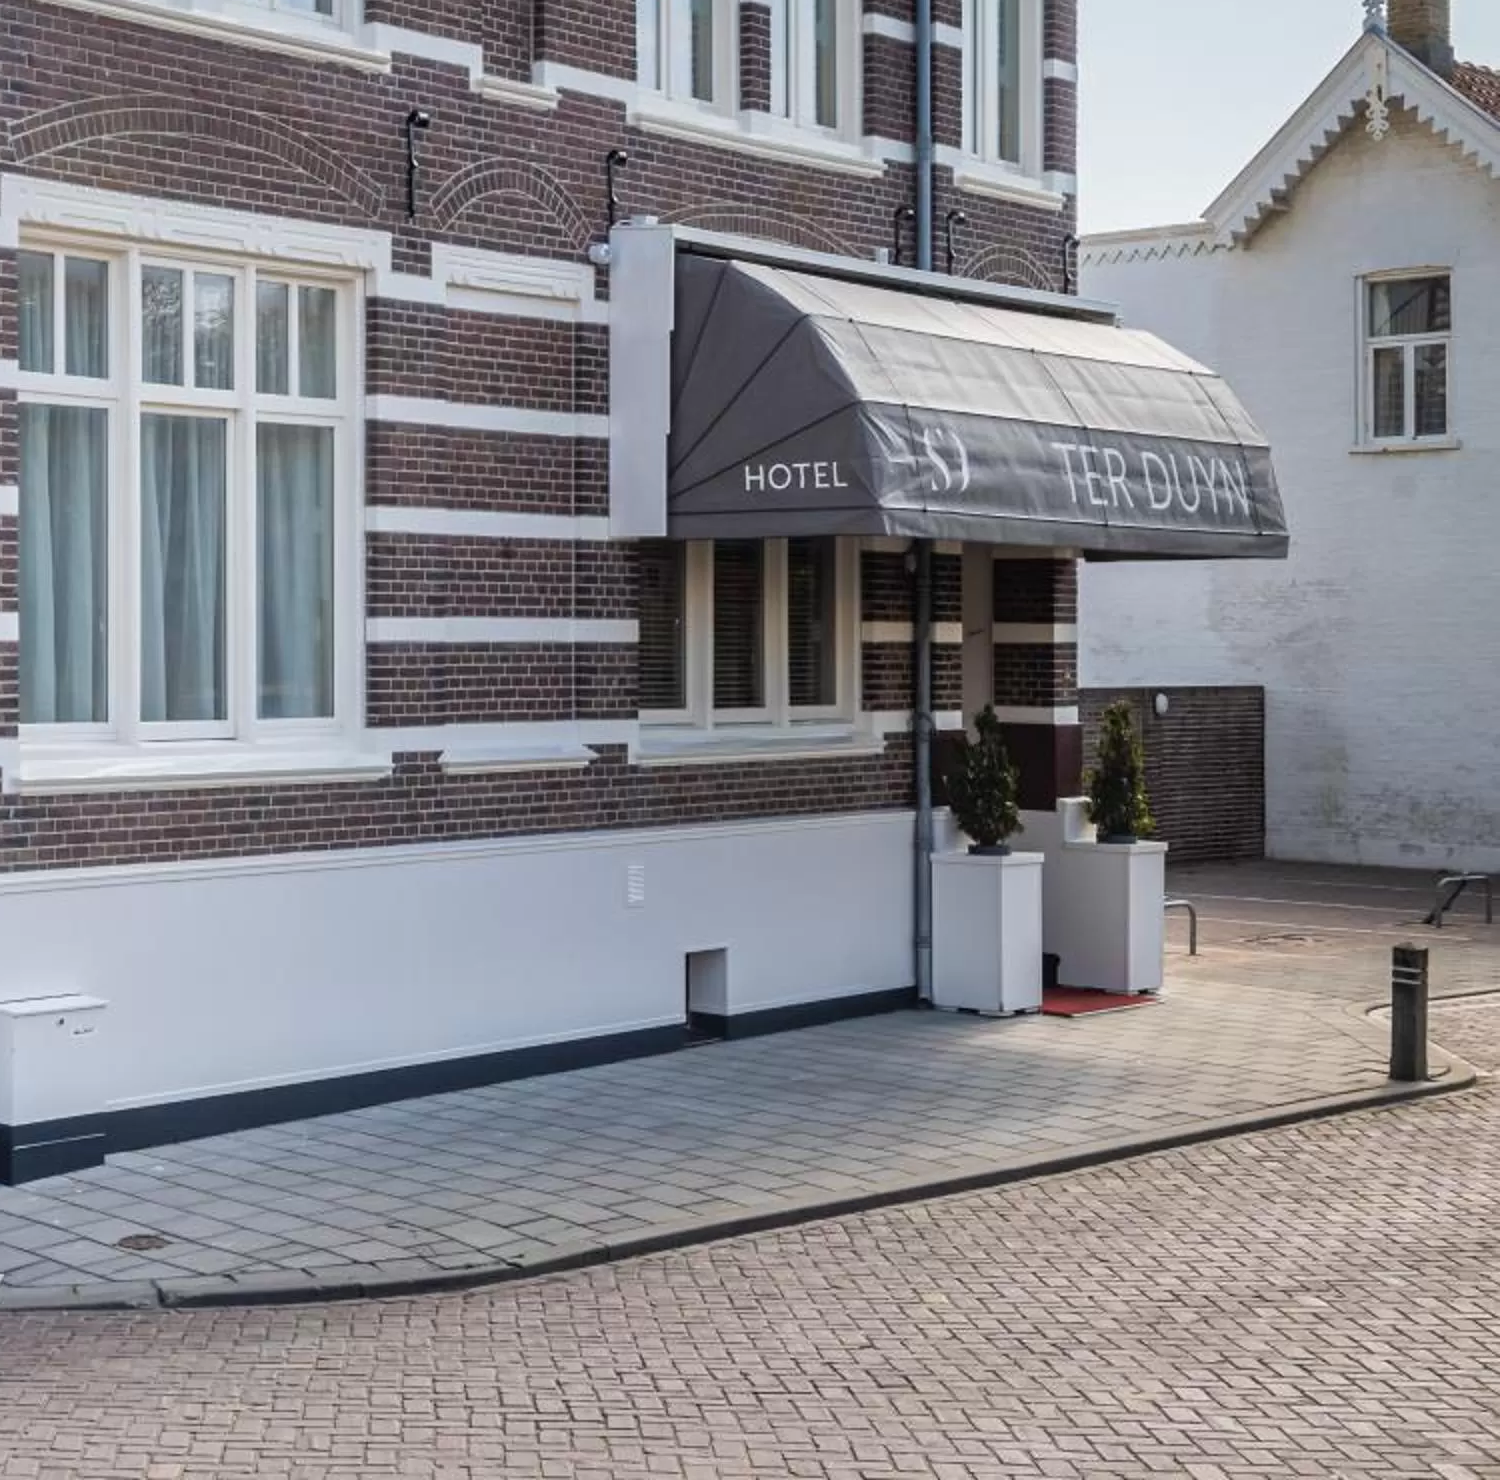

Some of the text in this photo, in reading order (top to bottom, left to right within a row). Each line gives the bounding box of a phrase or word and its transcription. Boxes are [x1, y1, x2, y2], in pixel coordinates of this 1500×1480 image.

[744, 461, 849, 491] HOTEL
[1051, 441, 1250, 516] TER DUYN
